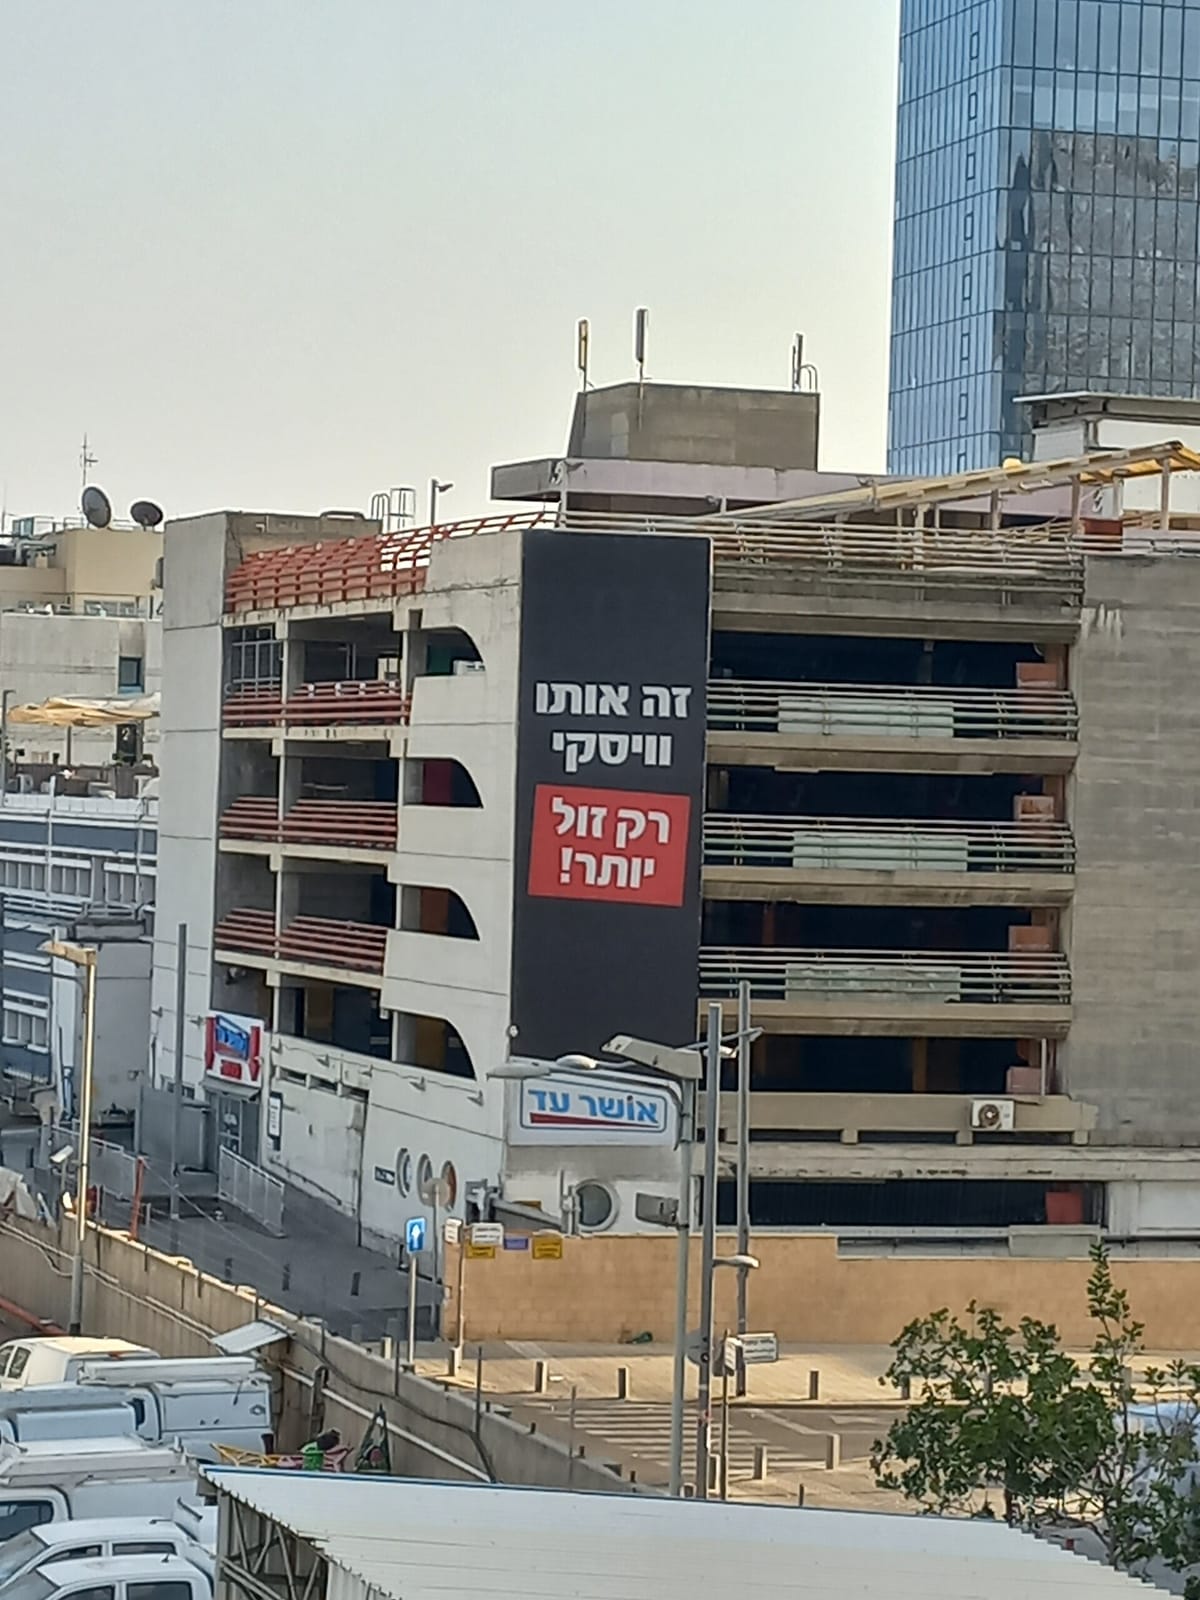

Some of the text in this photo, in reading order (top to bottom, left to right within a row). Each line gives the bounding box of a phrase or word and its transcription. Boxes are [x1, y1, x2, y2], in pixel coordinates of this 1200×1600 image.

[535, 682, 692, 718] זה אותו
[552, 732, 672, 773] וויסקי
[552, 796, 670, 848] רק זול
[560, 846, 656, 888] יותר!
[527, 1088, 570, 1113] עד
